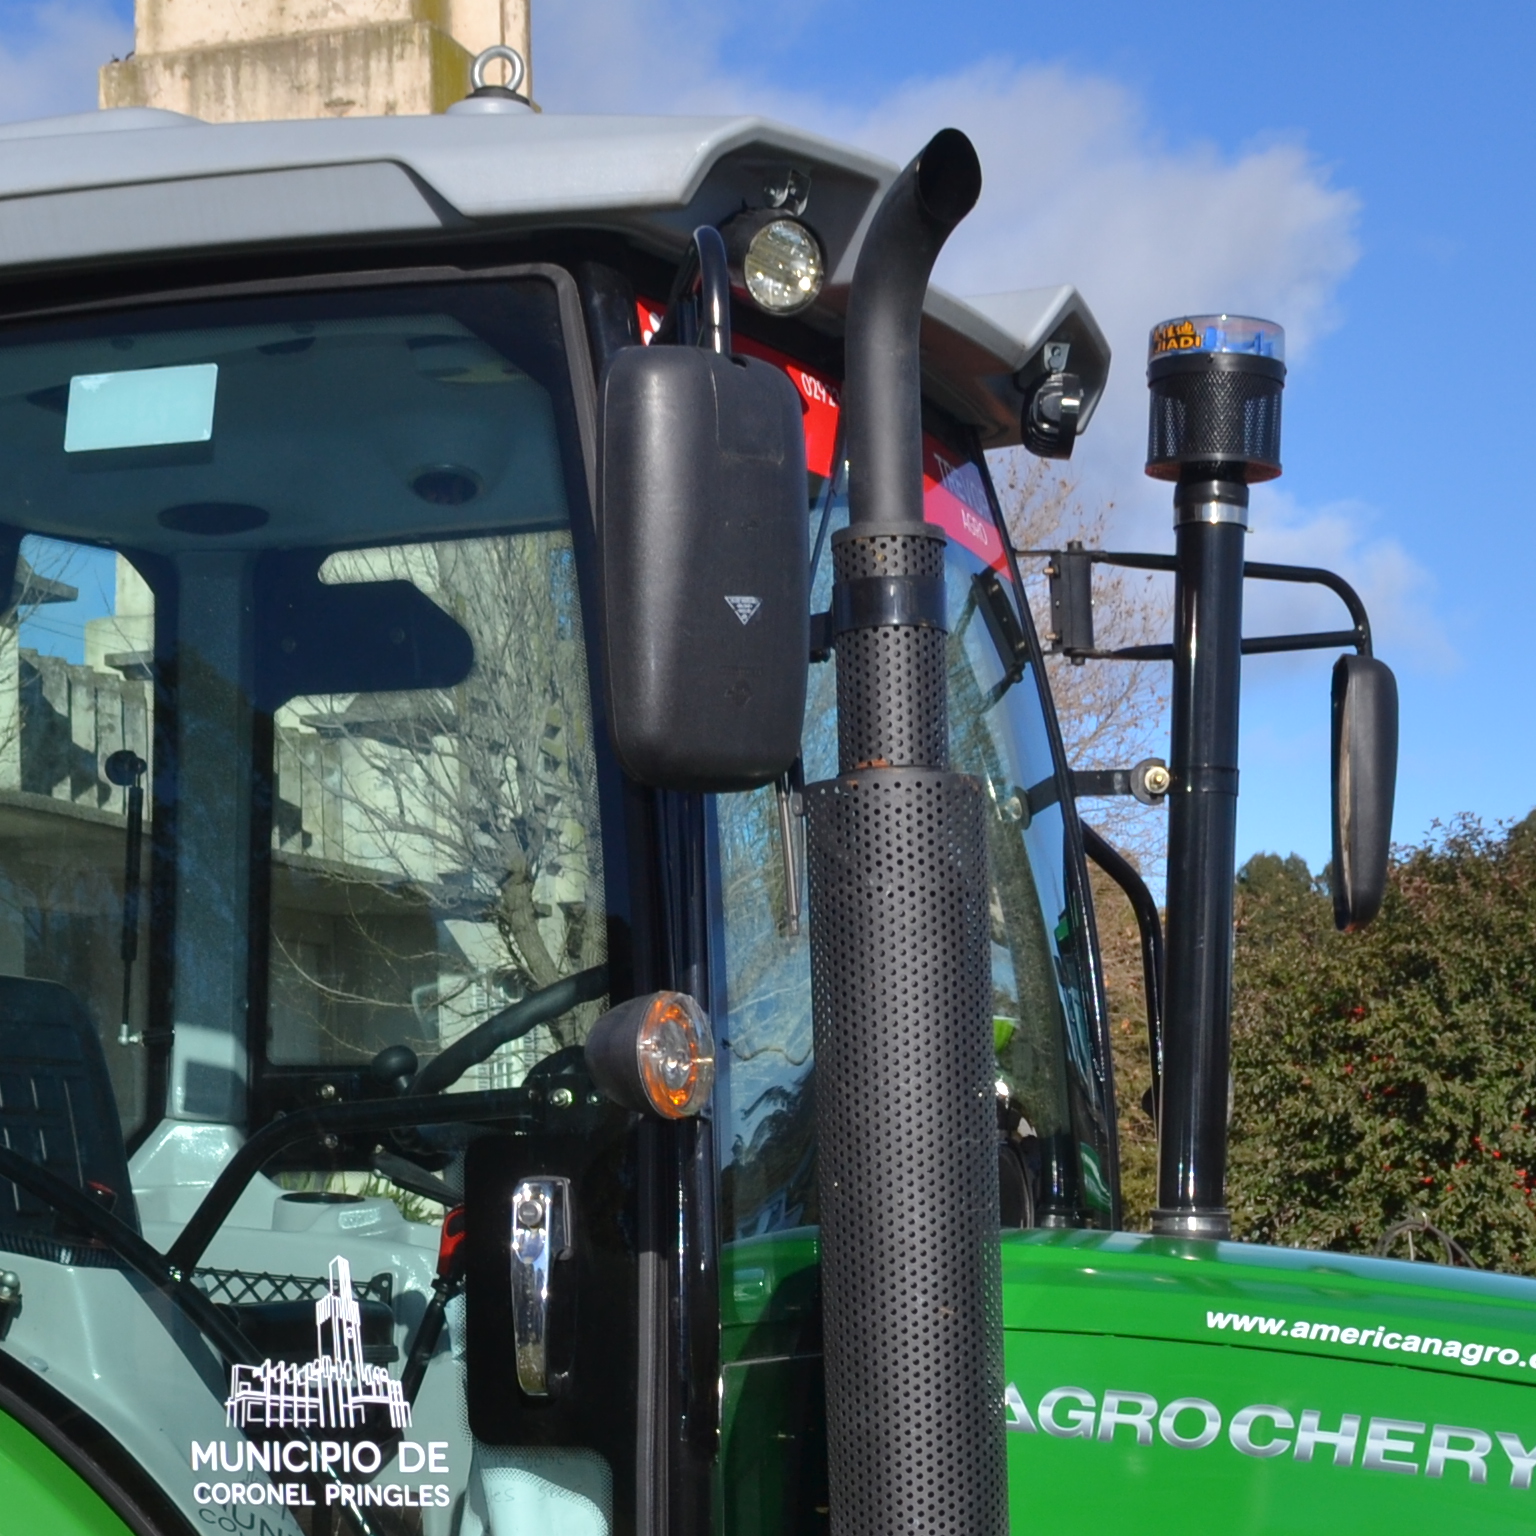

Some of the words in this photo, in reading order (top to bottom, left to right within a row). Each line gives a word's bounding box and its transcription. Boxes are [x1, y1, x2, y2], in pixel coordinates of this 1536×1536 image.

[191, 1440, 381, 1473] MUNICIPIO
[398, 1441, 450, 1473] DE
[193, 1482, 316, 1506] CORONEL
[325, 1484, 450, 1507] PRINGLES
